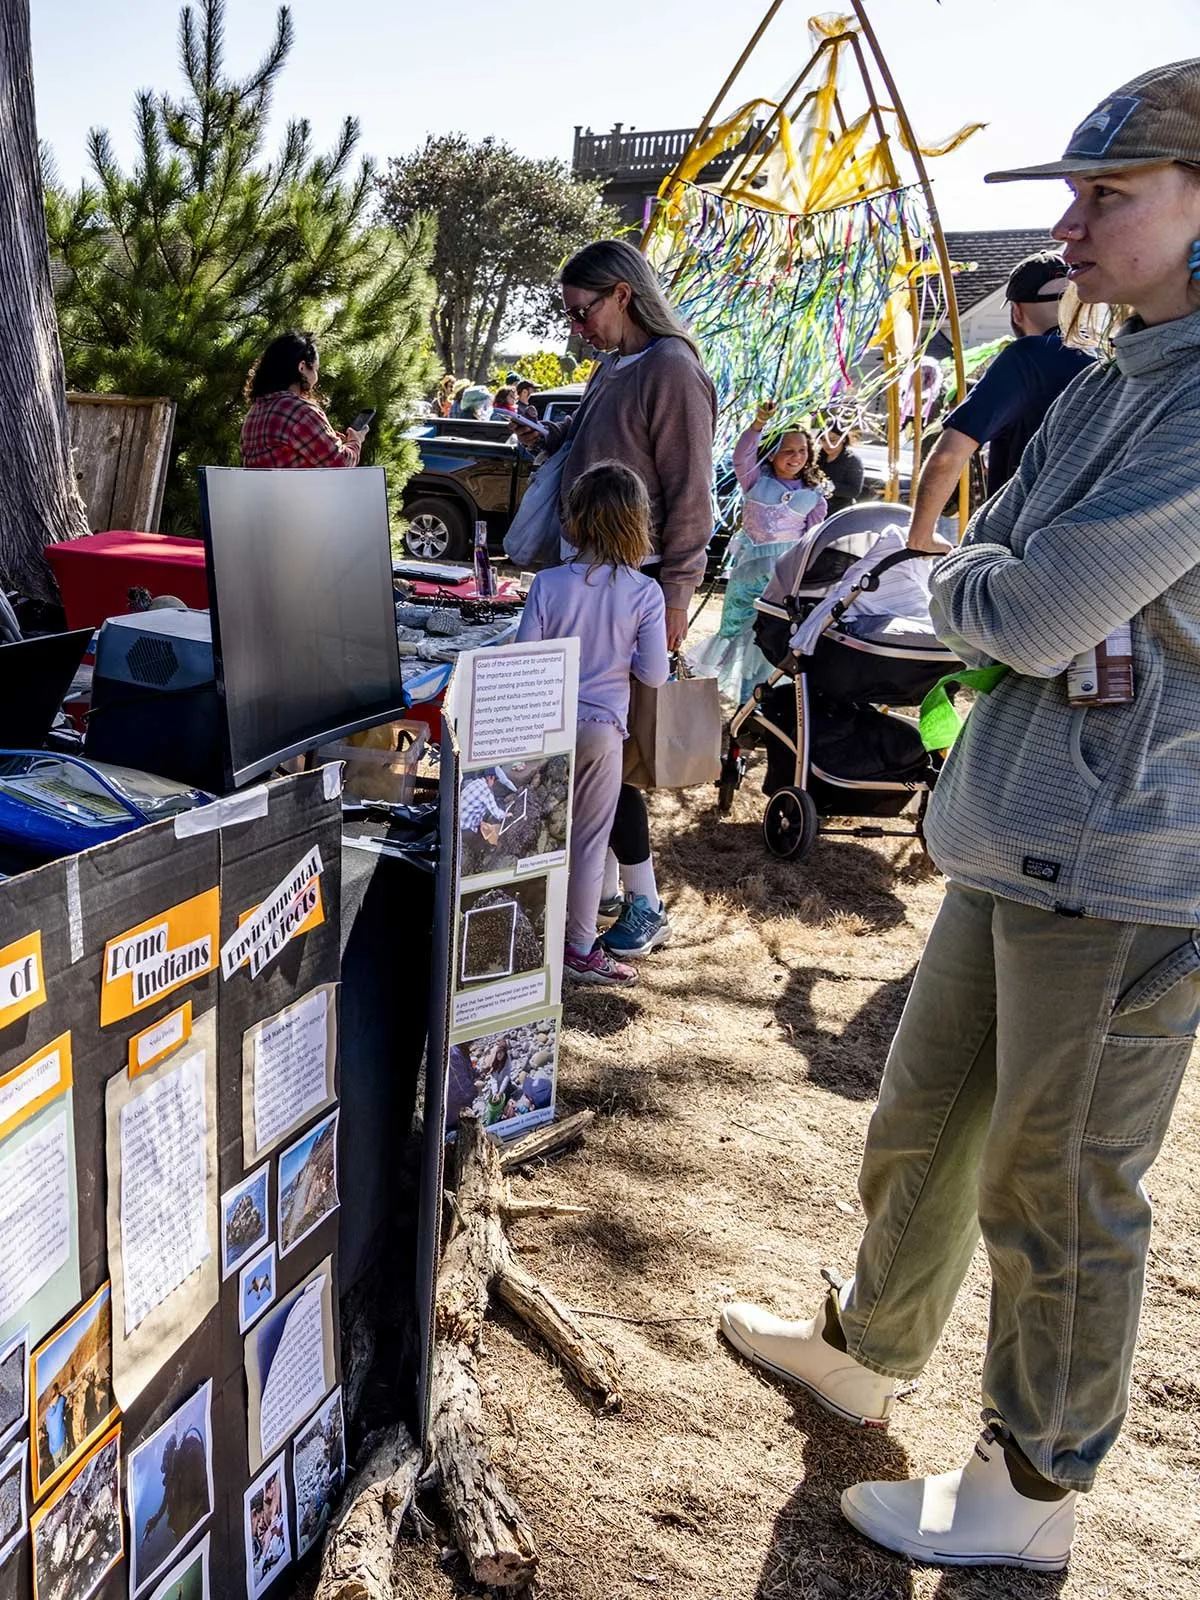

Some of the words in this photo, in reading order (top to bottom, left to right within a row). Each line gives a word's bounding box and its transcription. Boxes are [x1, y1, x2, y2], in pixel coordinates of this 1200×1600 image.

[227, 856, 320, 971] Environmental
[252, 884, 317, 970] Projects
[10, 958, 32, 996] of
[111, 928, 168, 976] Pomo
[137, 941, 210, 999] Indians
